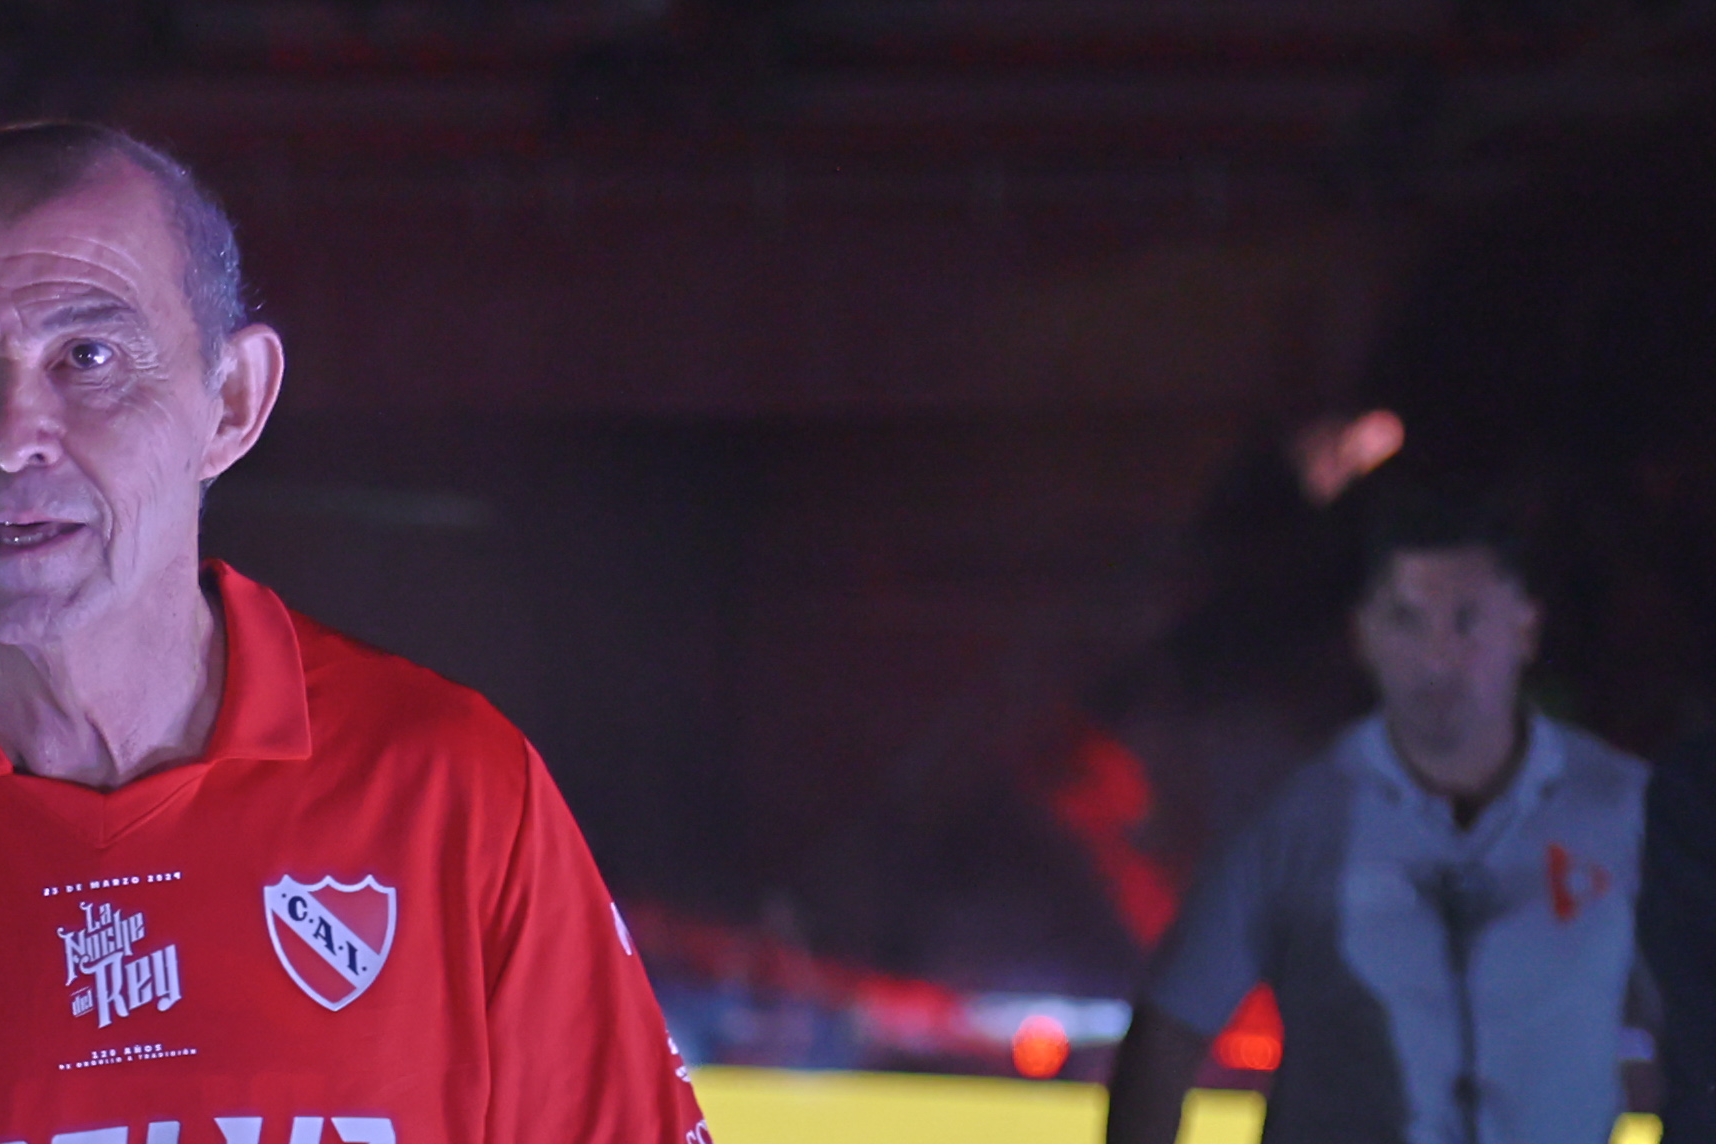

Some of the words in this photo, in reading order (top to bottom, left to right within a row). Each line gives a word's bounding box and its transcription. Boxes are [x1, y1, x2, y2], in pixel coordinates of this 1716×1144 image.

[65, 883, 83, 893] DE
[89, 876, 140, 890] MARZO
[147, 871, 182, 883] 2024
[79, 901, 113, 934] La
[79, 943, 183, 1029] Rey
